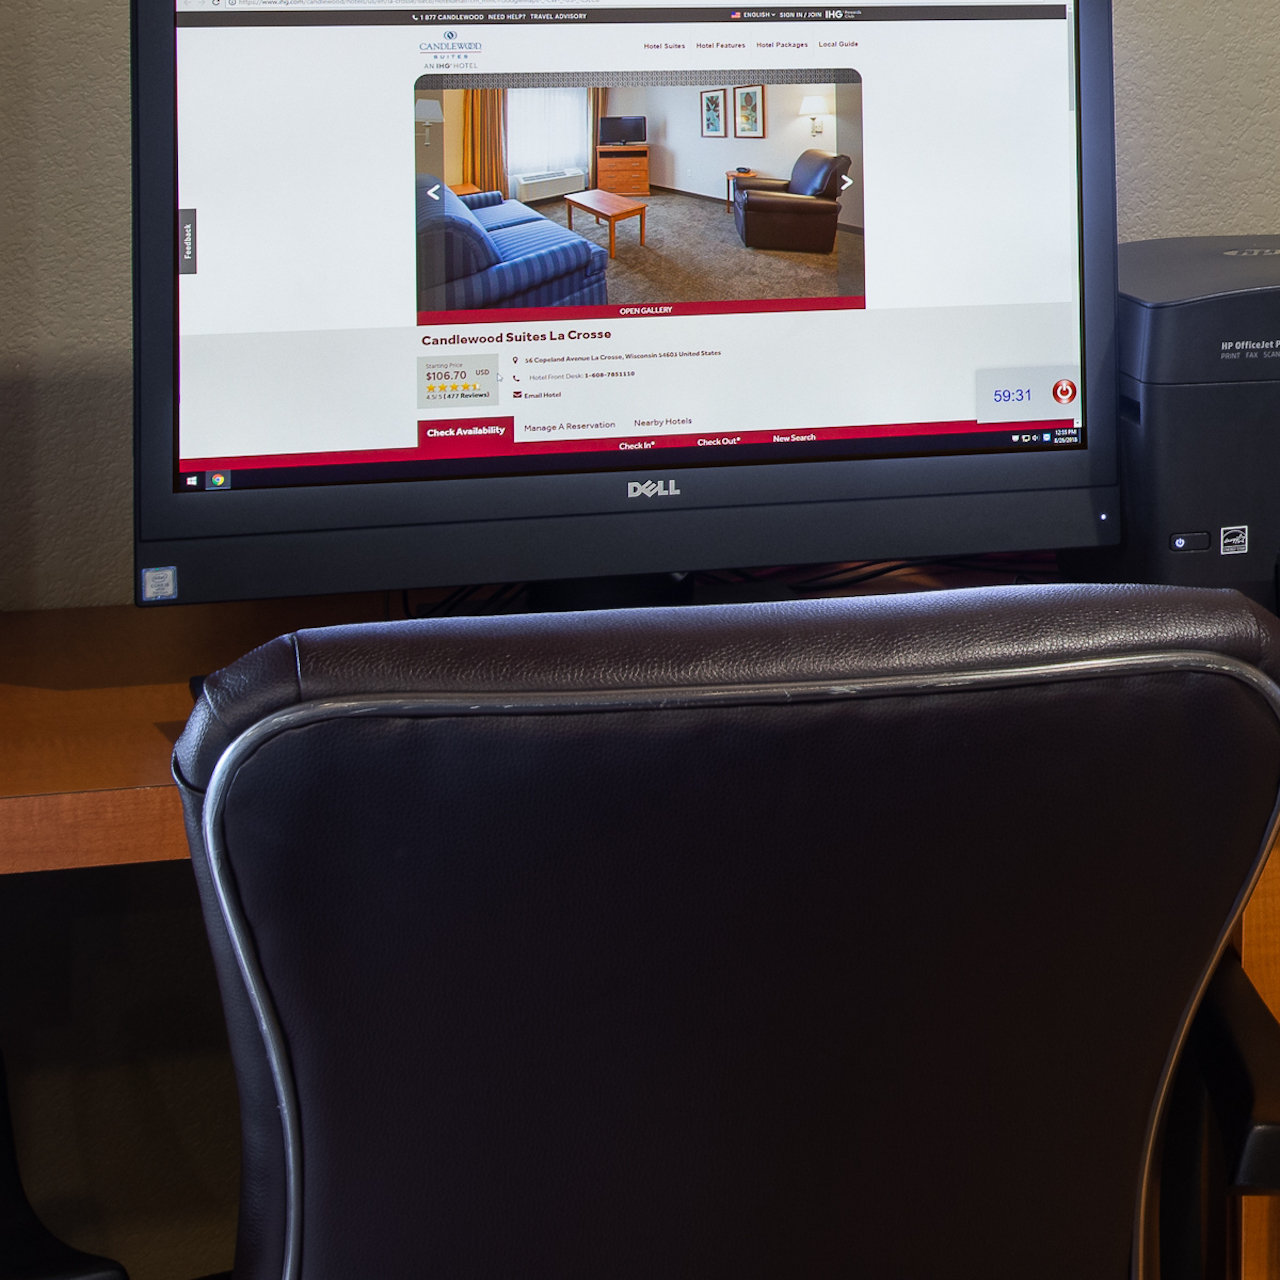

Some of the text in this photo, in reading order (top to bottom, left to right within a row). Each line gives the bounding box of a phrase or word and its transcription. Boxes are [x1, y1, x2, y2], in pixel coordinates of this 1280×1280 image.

[825, 10, 843, 19] IHG
[183, 223, 192, 259] Feedback
[619, 306, 673, 315] OPEN GALLERY
[421, 330, 612, 346] Candlewood Suites La Crosse
[1221, 341, 1233, 350] HP
[1235, 340, 1274, 350] OfficeJet
[1263, 350, 1280, 358] SCAN
[534, 356, 565, 364] Copeland
[426, 370, 467, 381] $106.70
[993, 388, 1031, 402] 59:31
[524, 424, 557, 433] Manage
[566, 421, 616, 430] Reservation
[634, 417, 693, 428] Nearby Hotels
[426, 426, 506, 437] Check Availability
[697, 438, 721, 447] Check
[772, 433, 817, 442] New Search
[619, 442, 643, 450] Check
[627, 479, 681, 498] DELL
